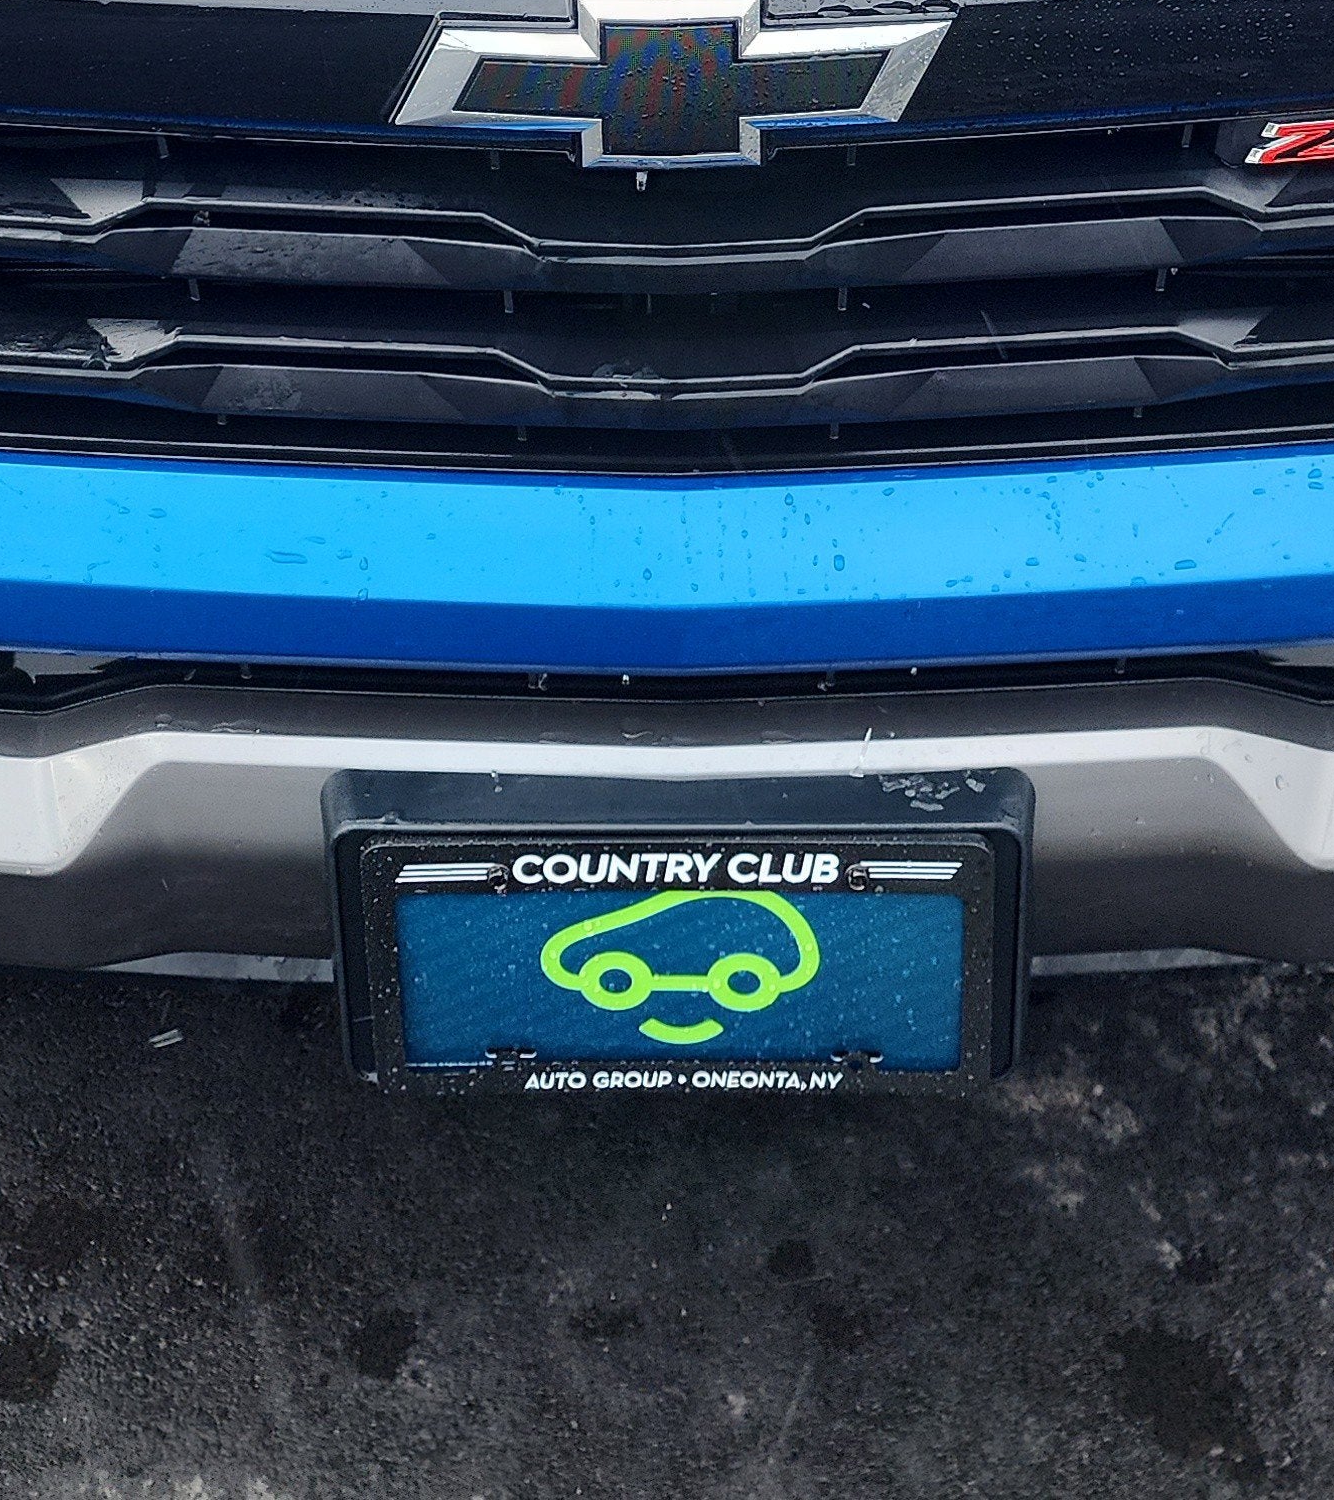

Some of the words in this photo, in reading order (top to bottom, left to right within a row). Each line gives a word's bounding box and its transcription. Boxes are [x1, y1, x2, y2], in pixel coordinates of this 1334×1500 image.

[512, 853, 722, 884] COUNTRY
[727, 853, 840, 883] CLUB
[524, 1071, 587, 1090] AUTO
[592, 1070, 673, 1090] GROUP
